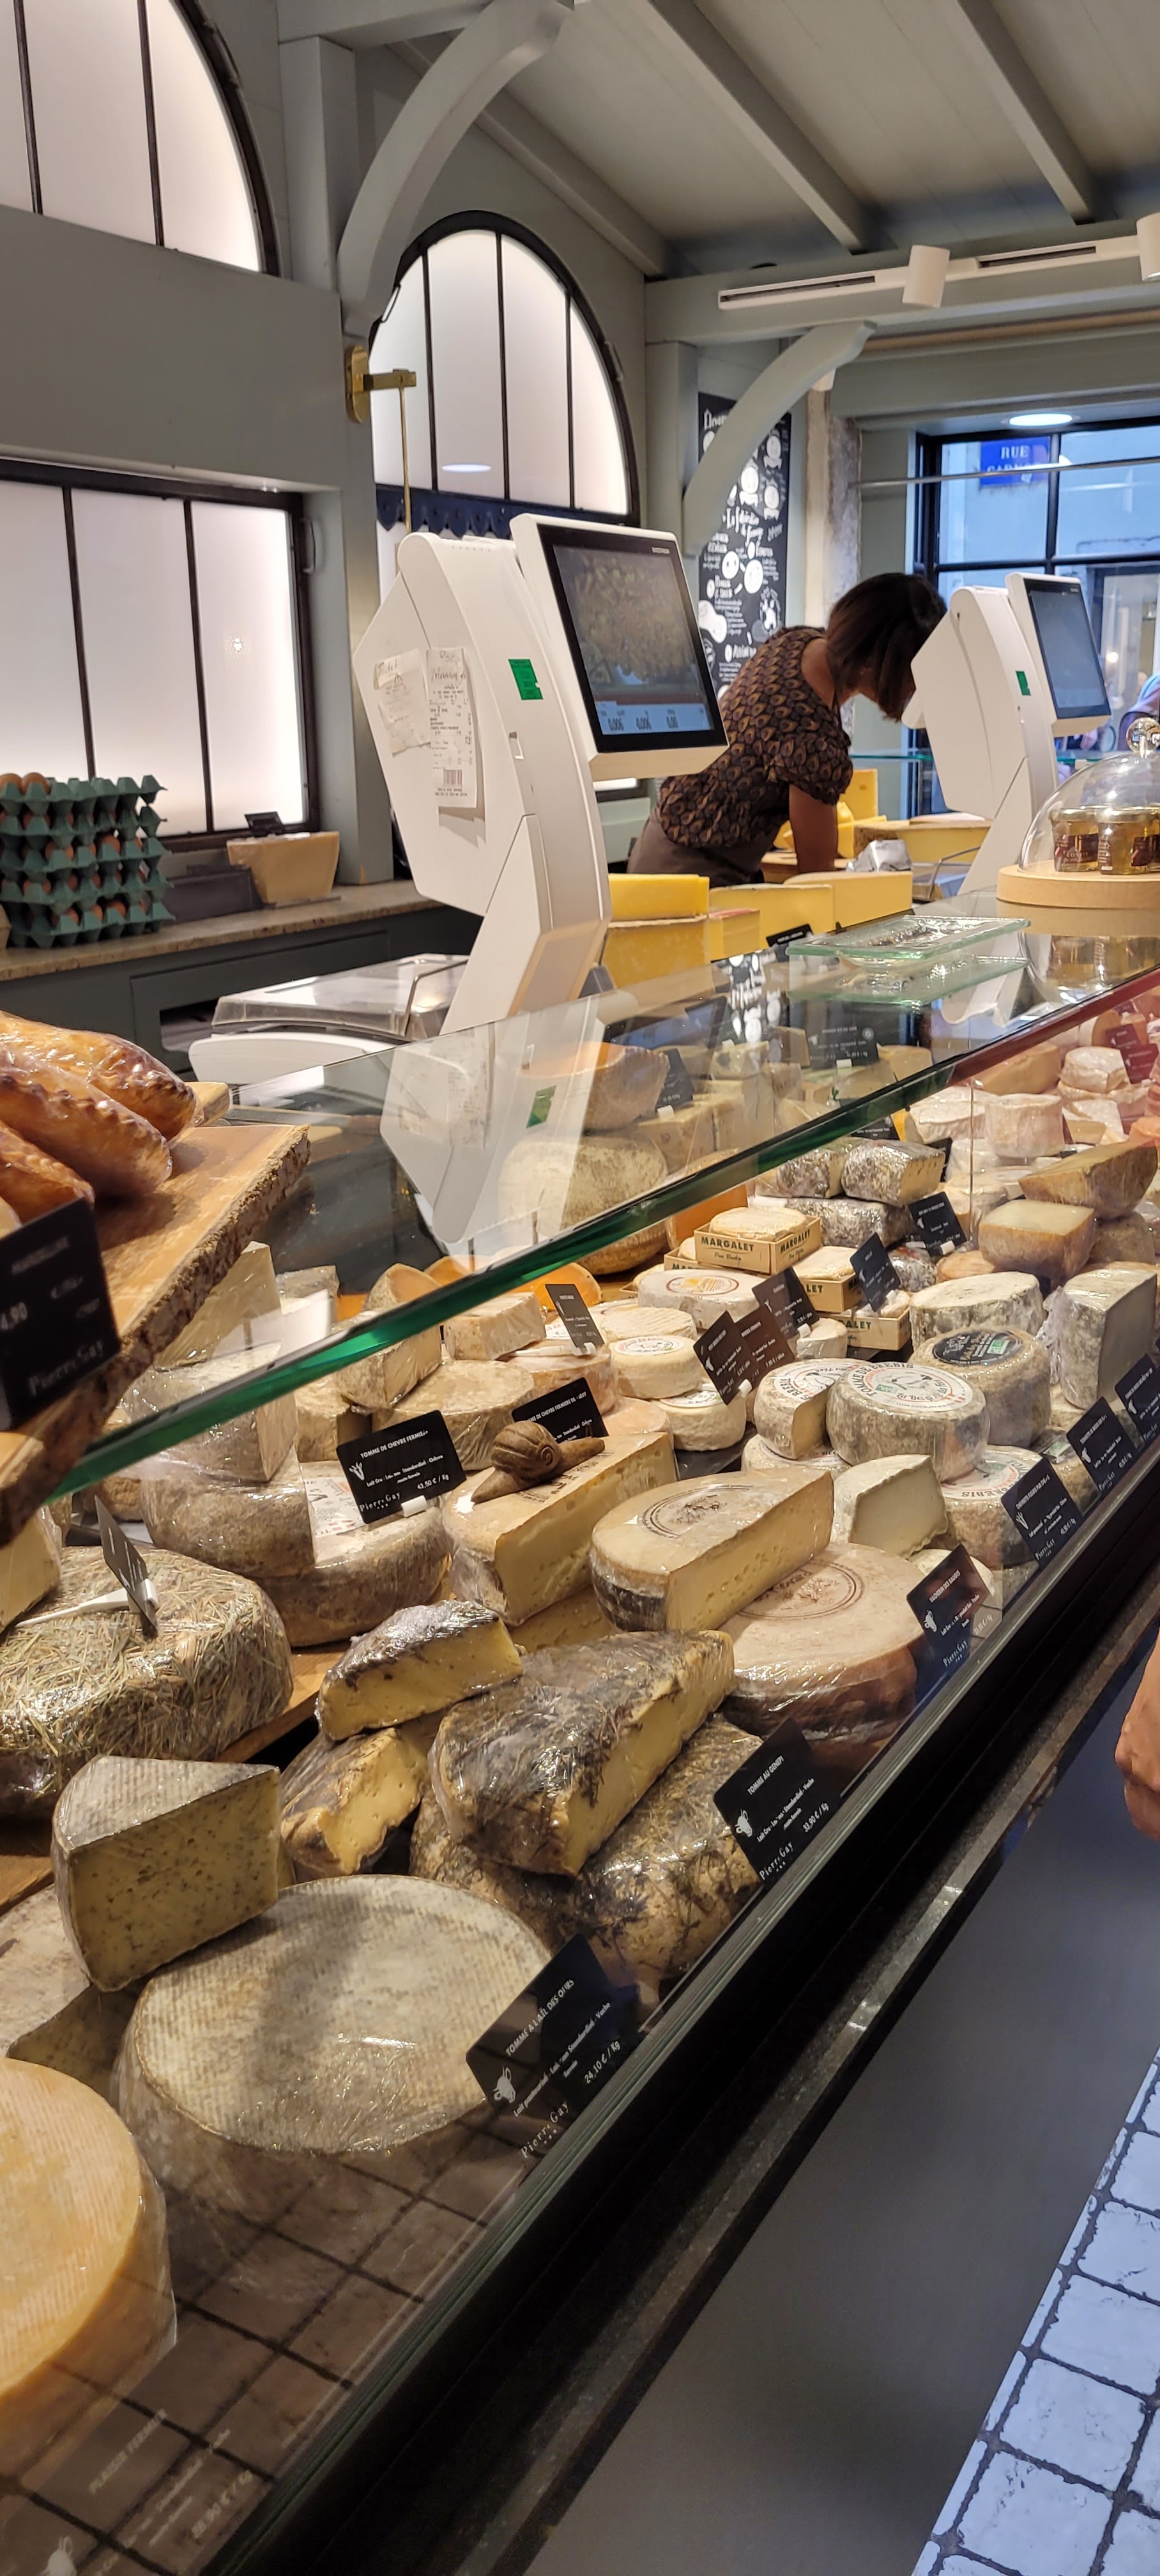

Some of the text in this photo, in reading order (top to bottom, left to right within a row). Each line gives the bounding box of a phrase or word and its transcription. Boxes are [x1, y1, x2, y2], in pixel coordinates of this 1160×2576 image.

[1001, 445, 1029, 459] RUE
[701, 1236, 754, 1252] MARGALET
[780, 1229, 811, 1254] MARGALET
[859, 1366, 872, 1375] DE
[852, 1374, 878, 1397] TOMME
[360, 1447, 380, 1459] TOMME
[387, 1438, 406, 1448] CHEVRE
[406, 1430, 428, 1441] FERMIE
[417, 1480, 432, 1489] 43,50
[385, 1492, 400, 1501] Gay
[747, 1755, 784, 1795] TOMME AU GENEPI
[802, 1815, 816, 1832] 33,90
[814, 1811, 820, 1819] €
[820, 1802, 829, 1811] Kg
[779, 1842, 793, 1857] Gay
[595, 2002, 611, 2019] Vache
[505, 2027, 529, 2057] TOMME
[547, 1995, 559, 2011] DES
[584, 2060, 602, 2083] 24,10
[601, 2053, 607, 2064] €
[610, 2041, 620, 2052] Kg
[550, 2102, 569, 2127] Gay
